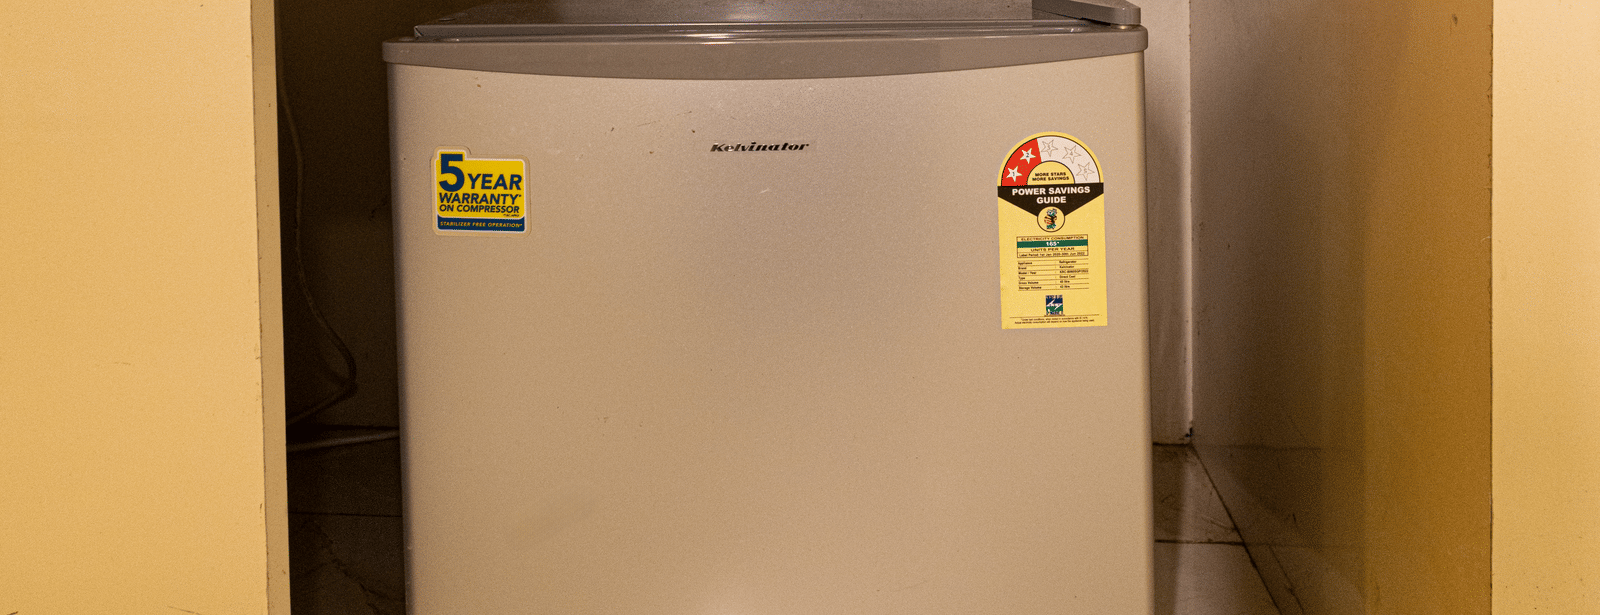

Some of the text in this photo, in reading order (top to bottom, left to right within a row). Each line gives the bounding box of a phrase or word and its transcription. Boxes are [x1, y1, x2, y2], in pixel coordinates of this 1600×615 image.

[710, 141, 809, 152] Kelvinator
[438, 153, 465, 192] 5
[467, 173, 522, 190] YEAR
[1011, 186, 1091, 196] POWER SAVINGS
[1036, 196, 1067, 205] GUIDE
[439, 204, 520, 214] ON COMPRESSOR
